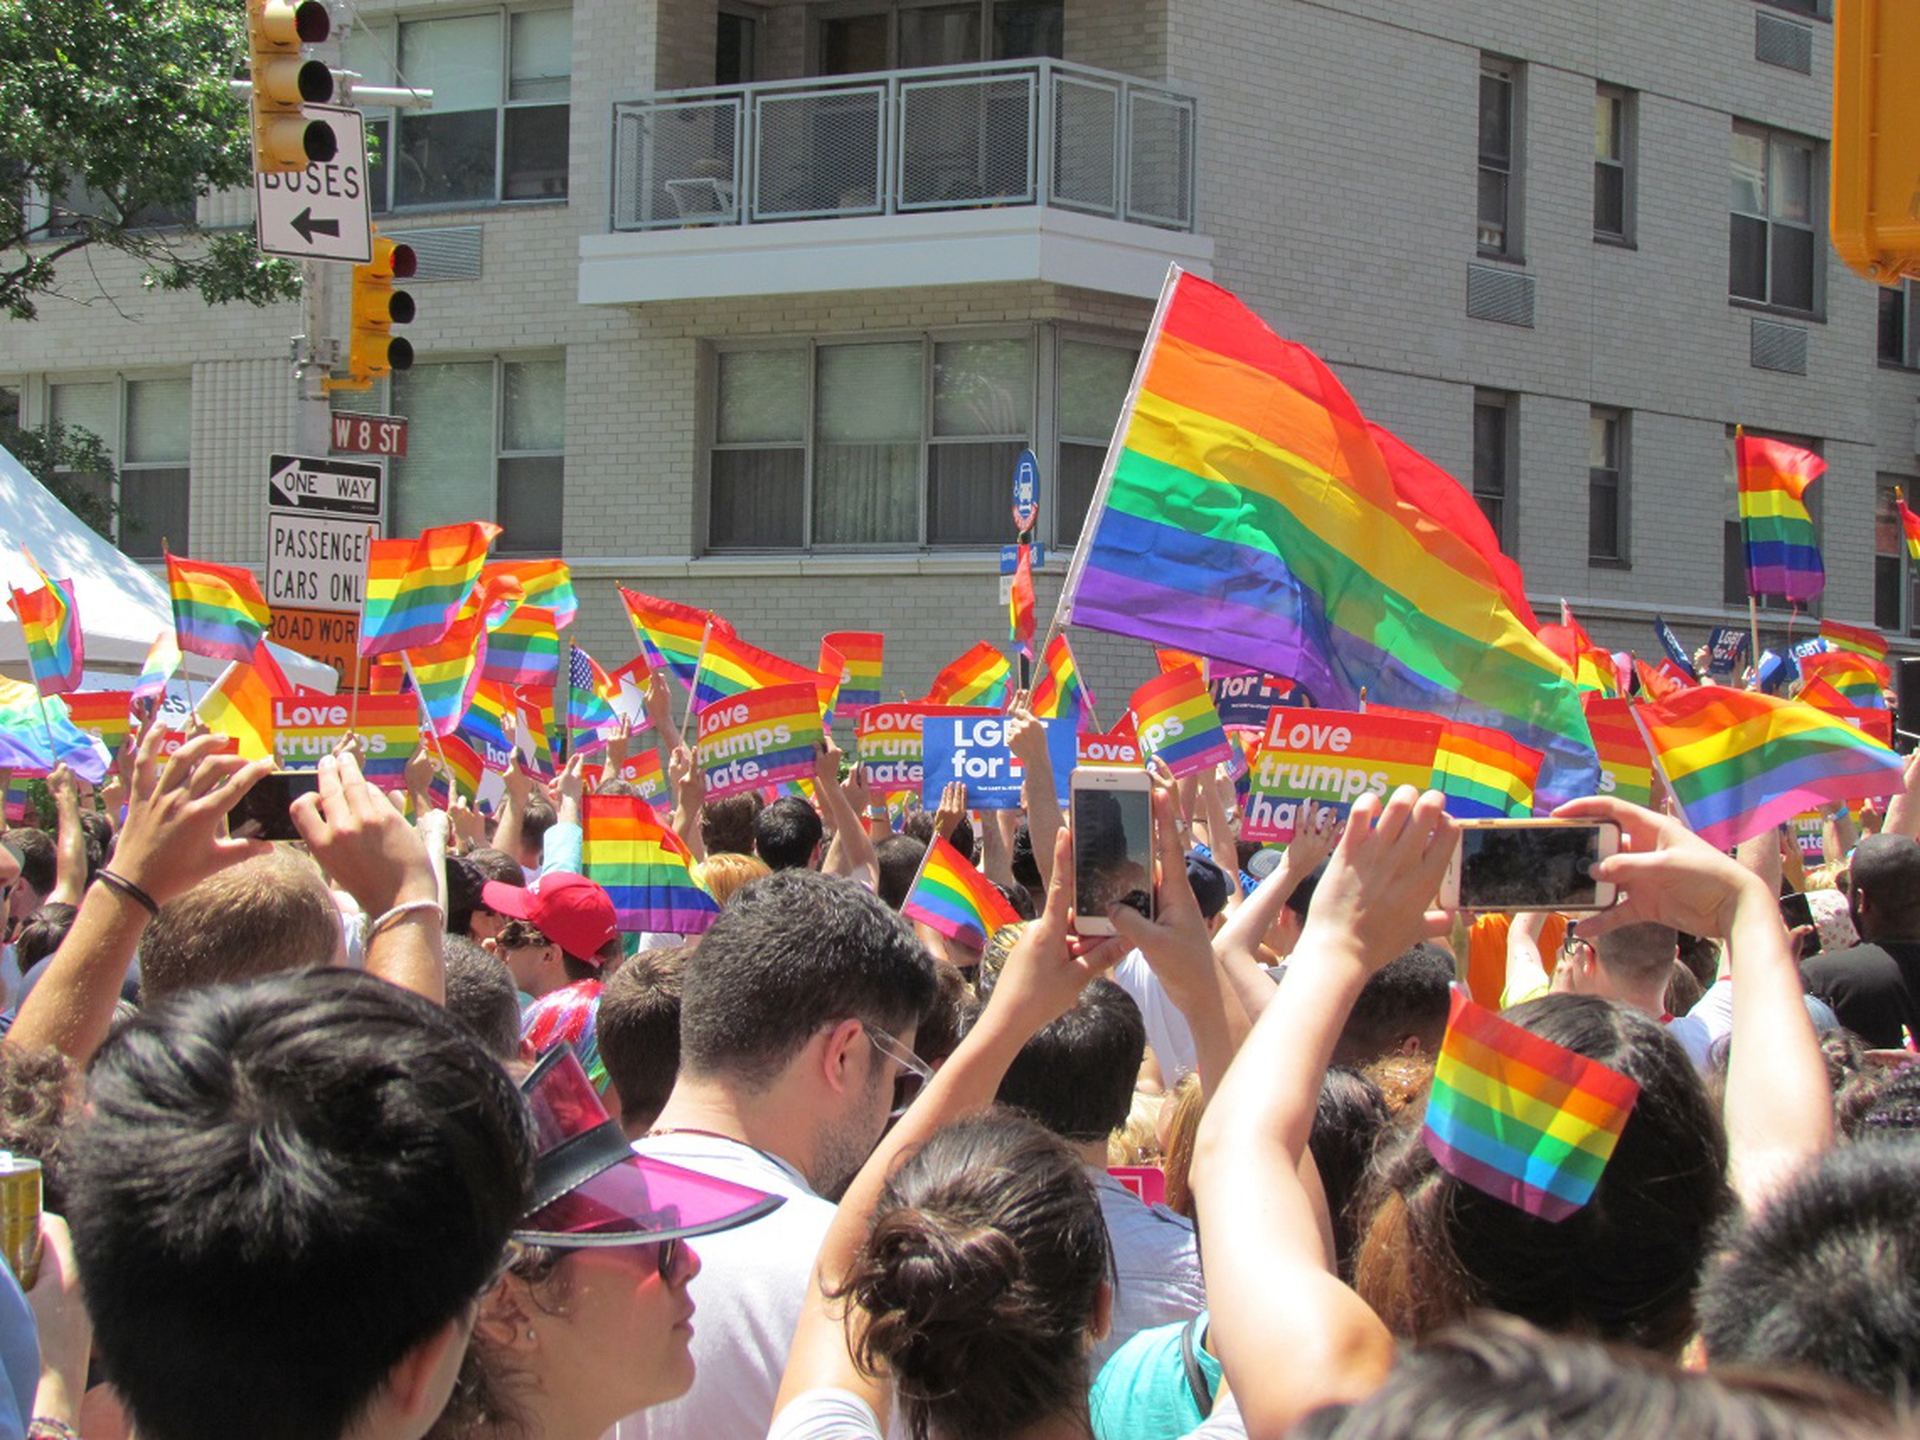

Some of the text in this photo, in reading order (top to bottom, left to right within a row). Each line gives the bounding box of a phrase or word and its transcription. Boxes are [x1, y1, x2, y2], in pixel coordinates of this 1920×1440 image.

[264, 162, 360, 199] BUSES
[336, 419, 401, 453] W 8 ST
[284, 472, 372, 499] ONE WAY
[275, 528, 370, 563] PASSENGE
[273, 569, 365, 603] CARS ONL
[319, 617, 357, 643] WOR
[1221, 676, 1258, 699] for
[275, 701, 348, 726] Love
[700, 704, 749, 737] Love
[863, 712, 927, 734] Love
[697, 724, 791, 766] trumps
[861, 738, 924, 758] trum
[1268, 713, 1352, 752] Love
[951, 749, 1004, 778] for
[1076, 736, 1136, 762] Love
[1259, 754, 1388, 803] trumps
